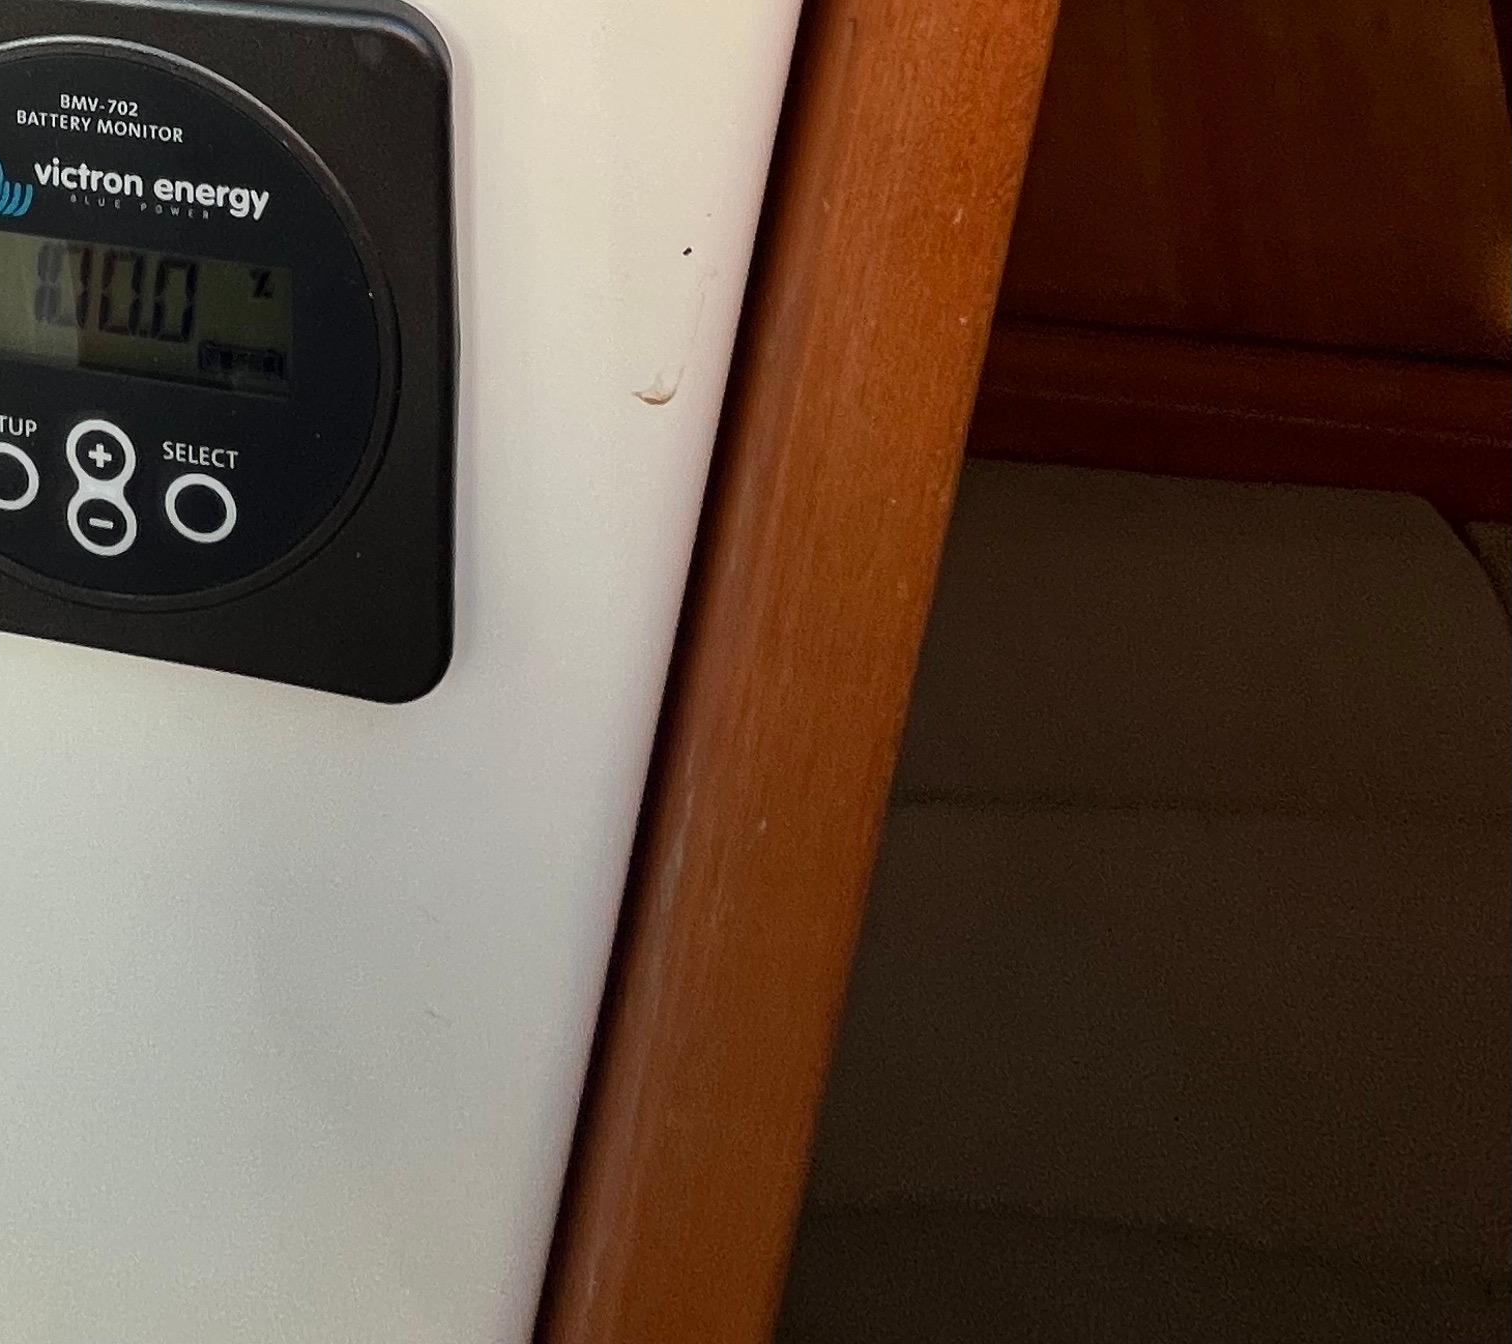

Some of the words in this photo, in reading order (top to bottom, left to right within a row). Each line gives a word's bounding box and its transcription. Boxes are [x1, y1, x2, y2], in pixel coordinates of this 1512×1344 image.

[59, 93, 140, 118] BMV-702
[16, 109, 93, 133] BATTERY
[96, 118, 184, 144] MONITOR
[33, 157, 144, 198] victron
[152, 178, 271, 222] energy
[69, 193, 122, 210] BLUE
[139, 202, 210, 221] POWER
[161, 439, 240, 471] SELECT
